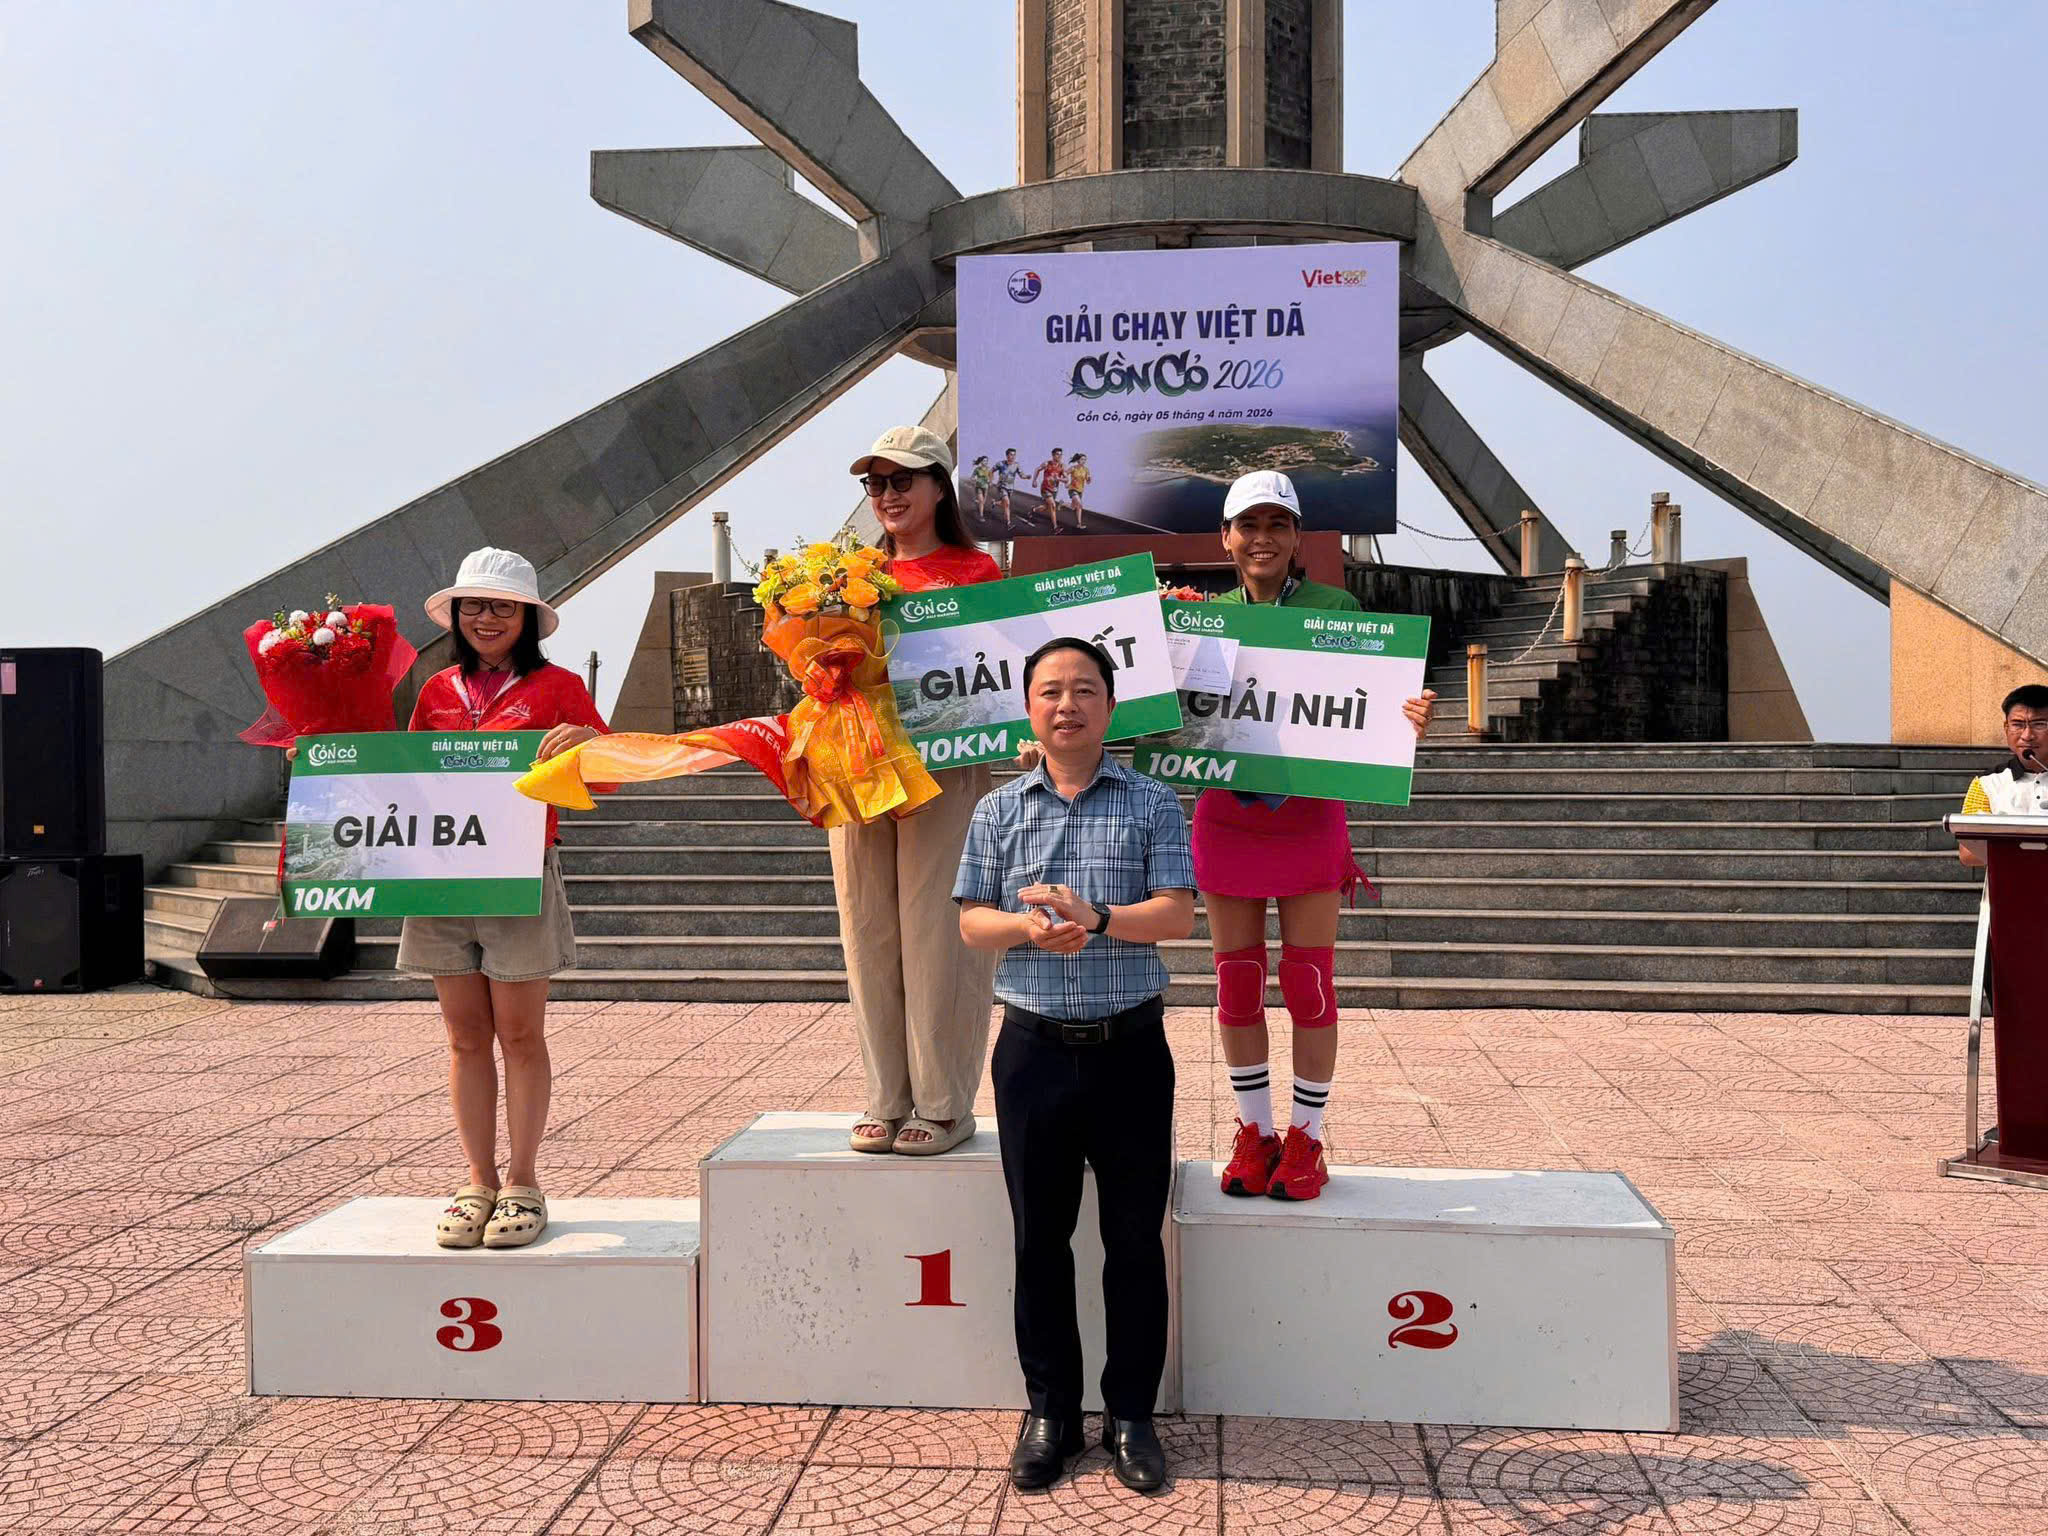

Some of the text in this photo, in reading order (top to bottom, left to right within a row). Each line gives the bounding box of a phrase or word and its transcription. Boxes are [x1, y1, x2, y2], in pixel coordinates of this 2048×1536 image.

[1046, 301, 1306, 347] GIẢI CHẠY VIỆT DÃ
[1213, 359, 1283, 389] 2026
[1124, 410, 1154, 423] ngày
[1156, 411, 1170, 420] 05
[1173, 409, 1205, 421] tháng
[1207, 409, 1216, 418] 4
[1218, 409, 1243, 418] năm
[1246, 408, 1273, 418] 2026
[1034, 565, 1122, 592] GIẢI CHẠY VIỆT DÃ
[1303, 616, 1395, 636] GIẢI CHẠY VIỆT DÃ
[919, 651, 1012, 701] GIẢI
[1187, 677, 1368, 730] GIẢI NHÌ
[431, 738, 519, 753] GIẢI CHẠY VIỆT DÃ
[917, 729, 1008, 764] 10KM
[1149, 752, 1238, 783] 10KM
[333, 803, 488, 848] GIẢI BA
[293, 886, 376, 912] 10KM
[905, 1249, 967, 1307] 1
[436, 1297, 503, 1352] 3
[1387, 1290, 1458, 1350] 2
